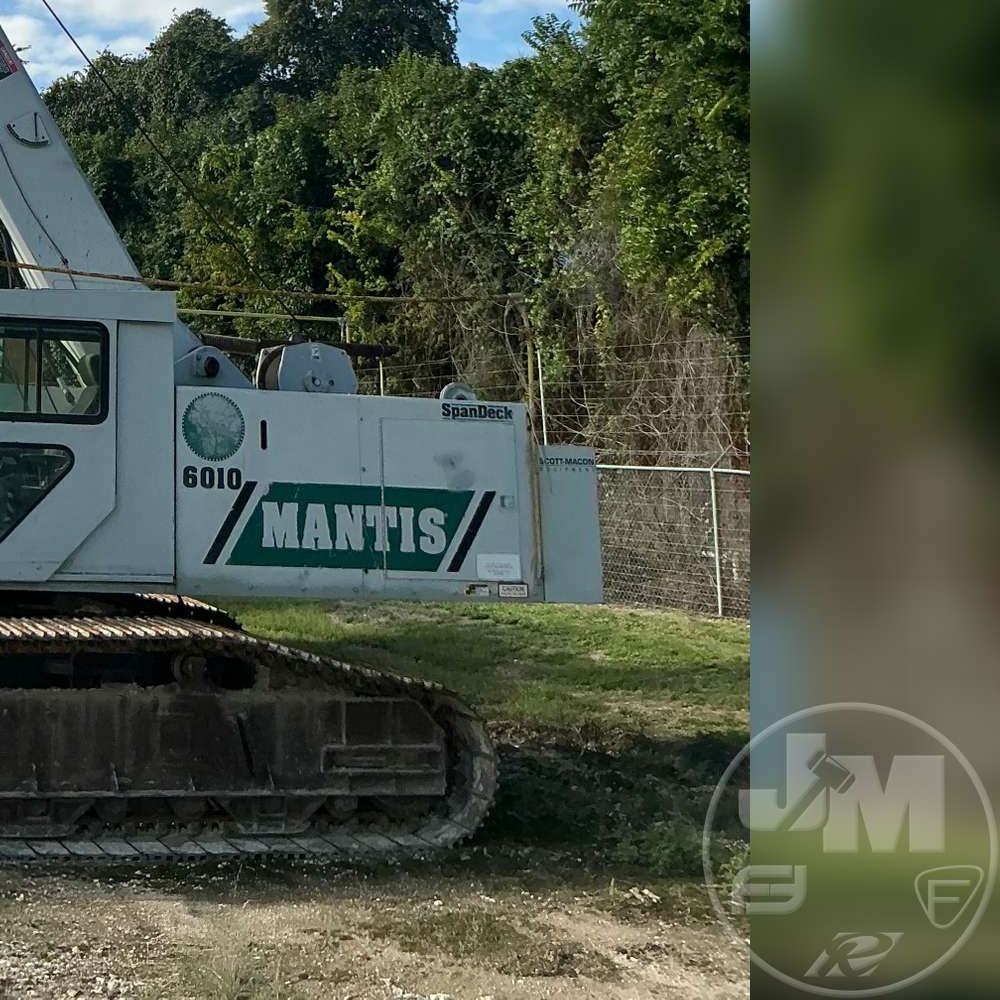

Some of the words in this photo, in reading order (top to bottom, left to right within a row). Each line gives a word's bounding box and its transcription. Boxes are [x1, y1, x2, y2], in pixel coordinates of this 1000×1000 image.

[441, 403, 513, 420] SpanDeck
[183, 465, 242, 490] 6010
[261, 500, 447, 554] MANTIS
